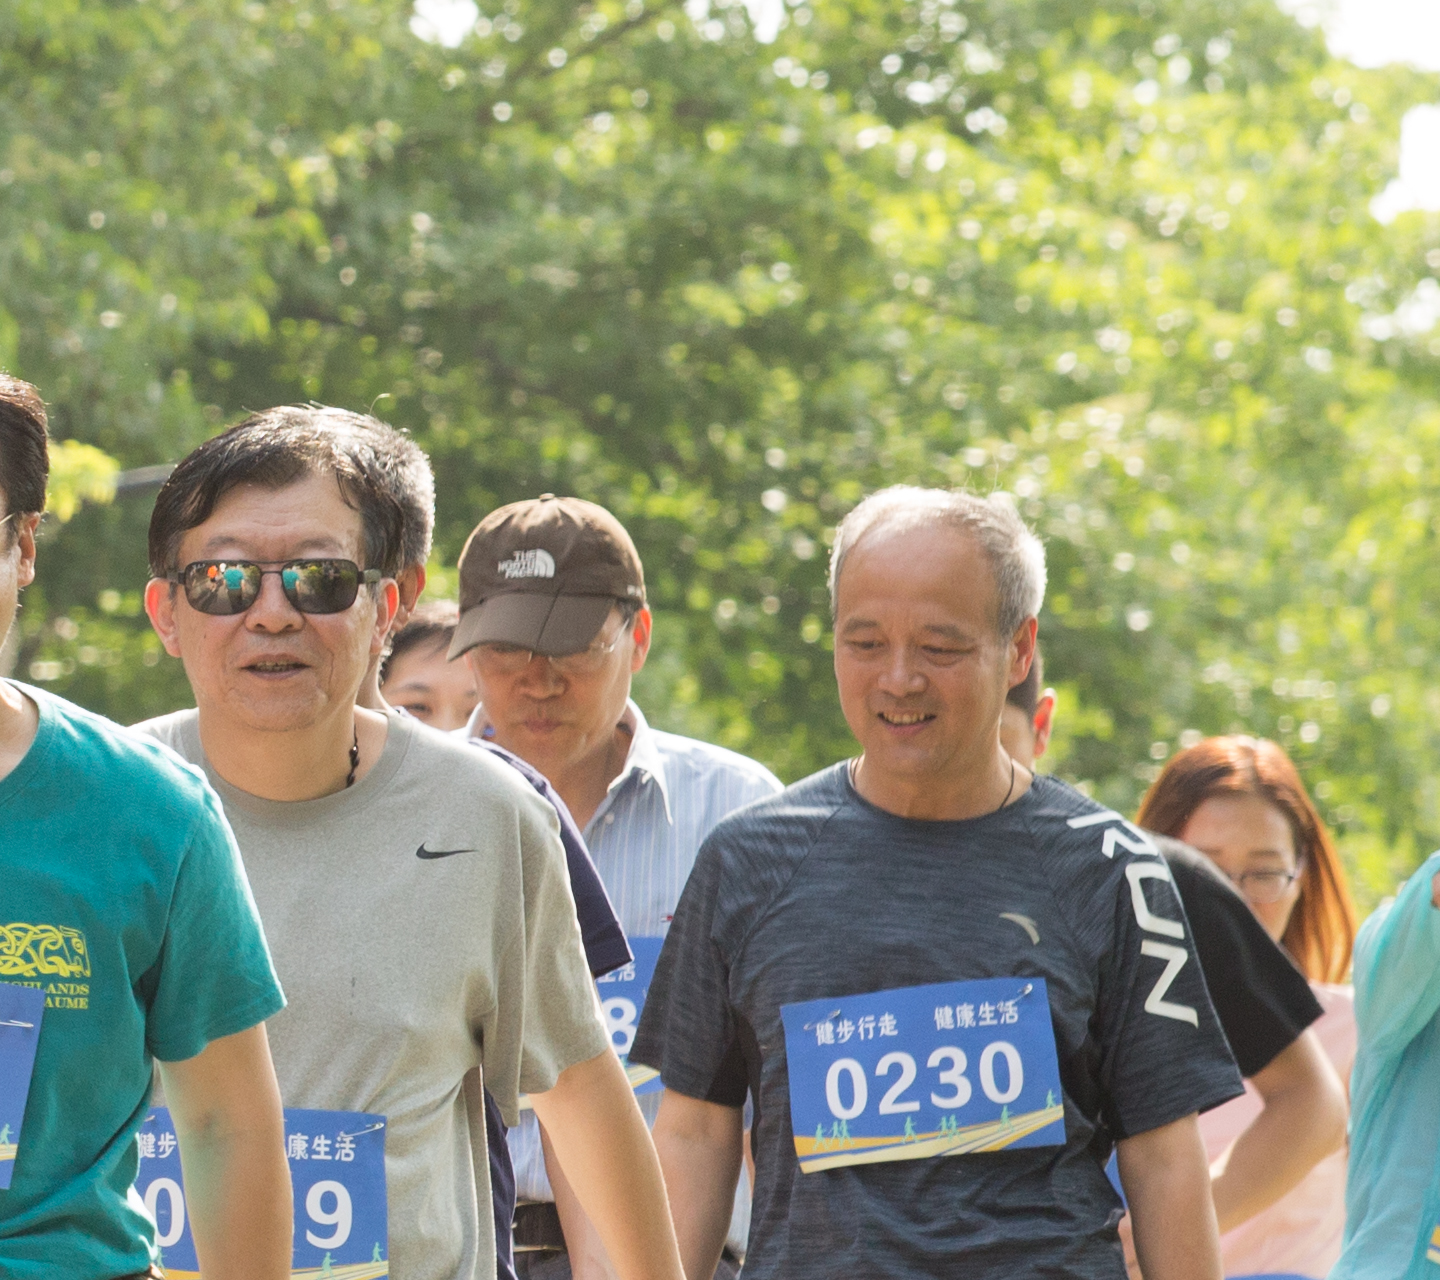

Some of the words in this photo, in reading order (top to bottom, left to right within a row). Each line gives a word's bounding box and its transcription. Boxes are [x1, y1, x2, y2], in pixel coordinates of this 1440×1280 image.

[815, 1011, 899, 1046] 健步行走
[933, 1000, 1019, 1030] 健康生活
[825, 1040, 1024, 1120] 0230
